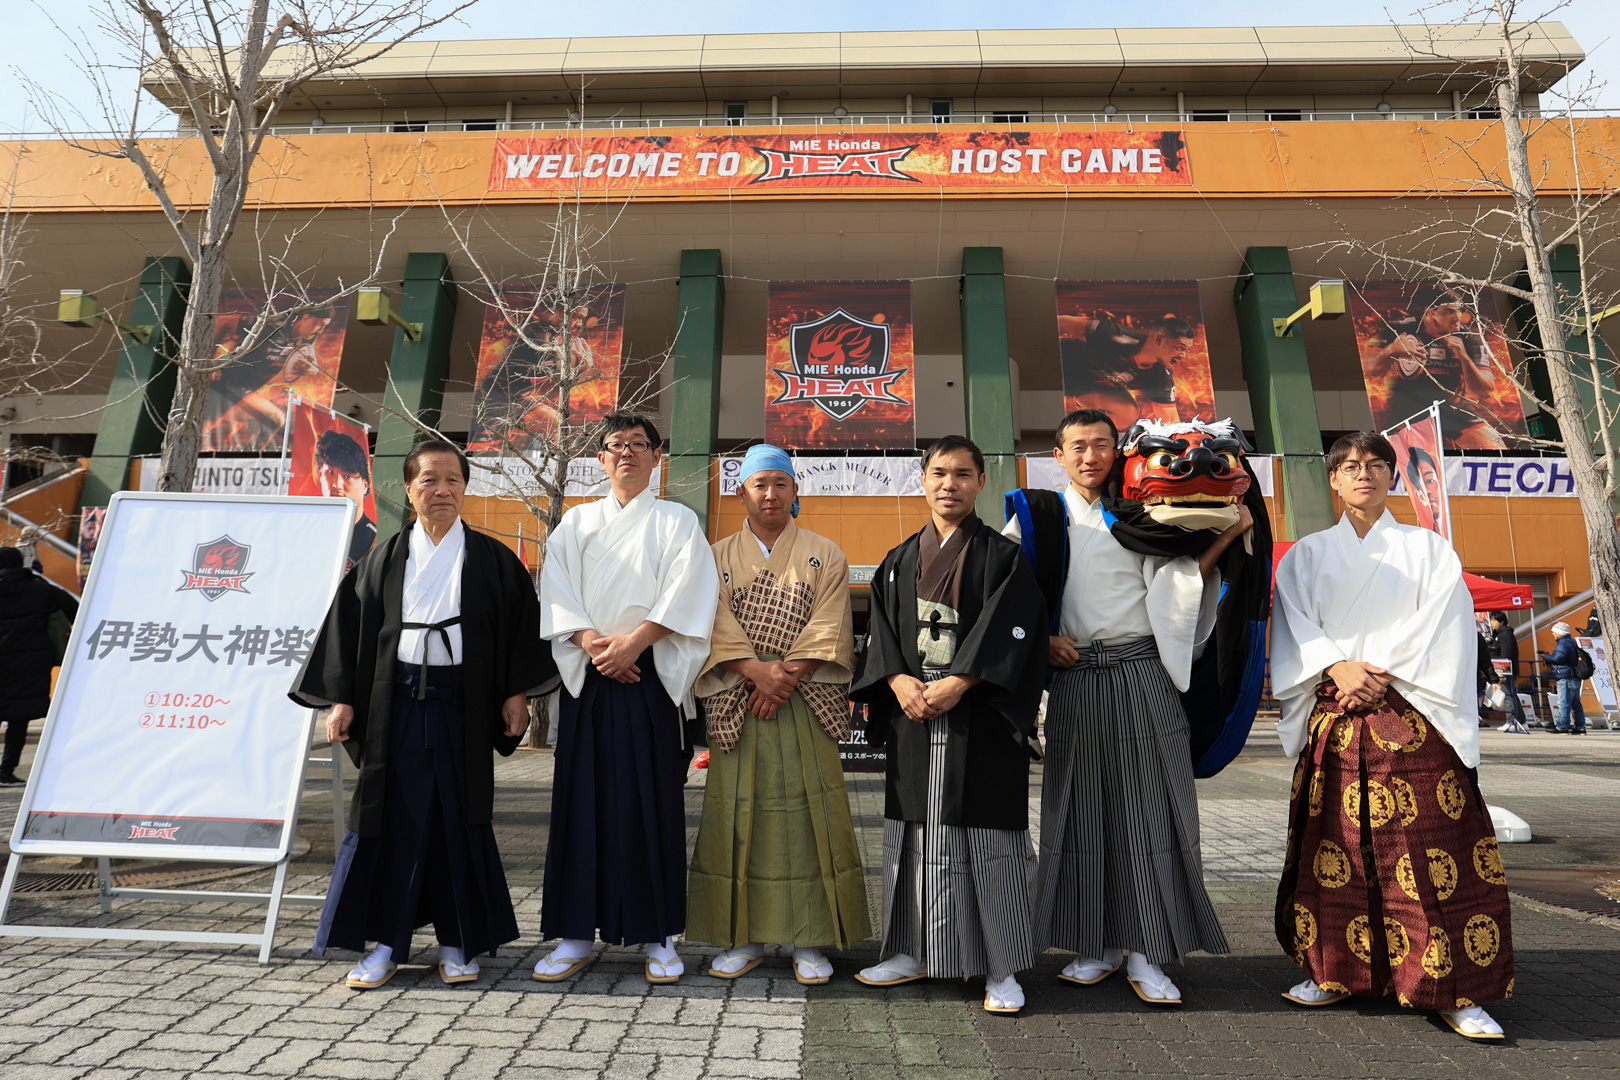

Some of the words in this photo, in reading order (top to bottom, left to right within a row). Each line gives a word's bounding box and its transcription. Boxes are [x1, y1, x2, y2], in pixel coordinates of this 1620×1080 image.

[789, 140, 821, 151] MIE
[827, 139, 881, 151] Honda
[505, 152, 682, 179] WELCOME
[695, 151, 741, 177] TO
[757, 149, 912, 182] HEAT
[949, 148, 1048, 174] HOST
[1060, 148, 1163, 173] GAME
[804, 364, 829, 375] MIE
[834, 364, 876, 375] Honda
[780, 371, 902, 401] HEAT
[194, 467, 243, 487] HINTO
[567, 465, 598, 477] OTEL
[796, 462, 837, 481] RANCK
[846, 462, 892, 486] MULLER
[1463, 462, 1576, 494] TECH
[183, 572, 248, 590] HEAT
[86, 619, 317, 667] 伊勢大神楽
[129, 826, 179, 840] HEAT
